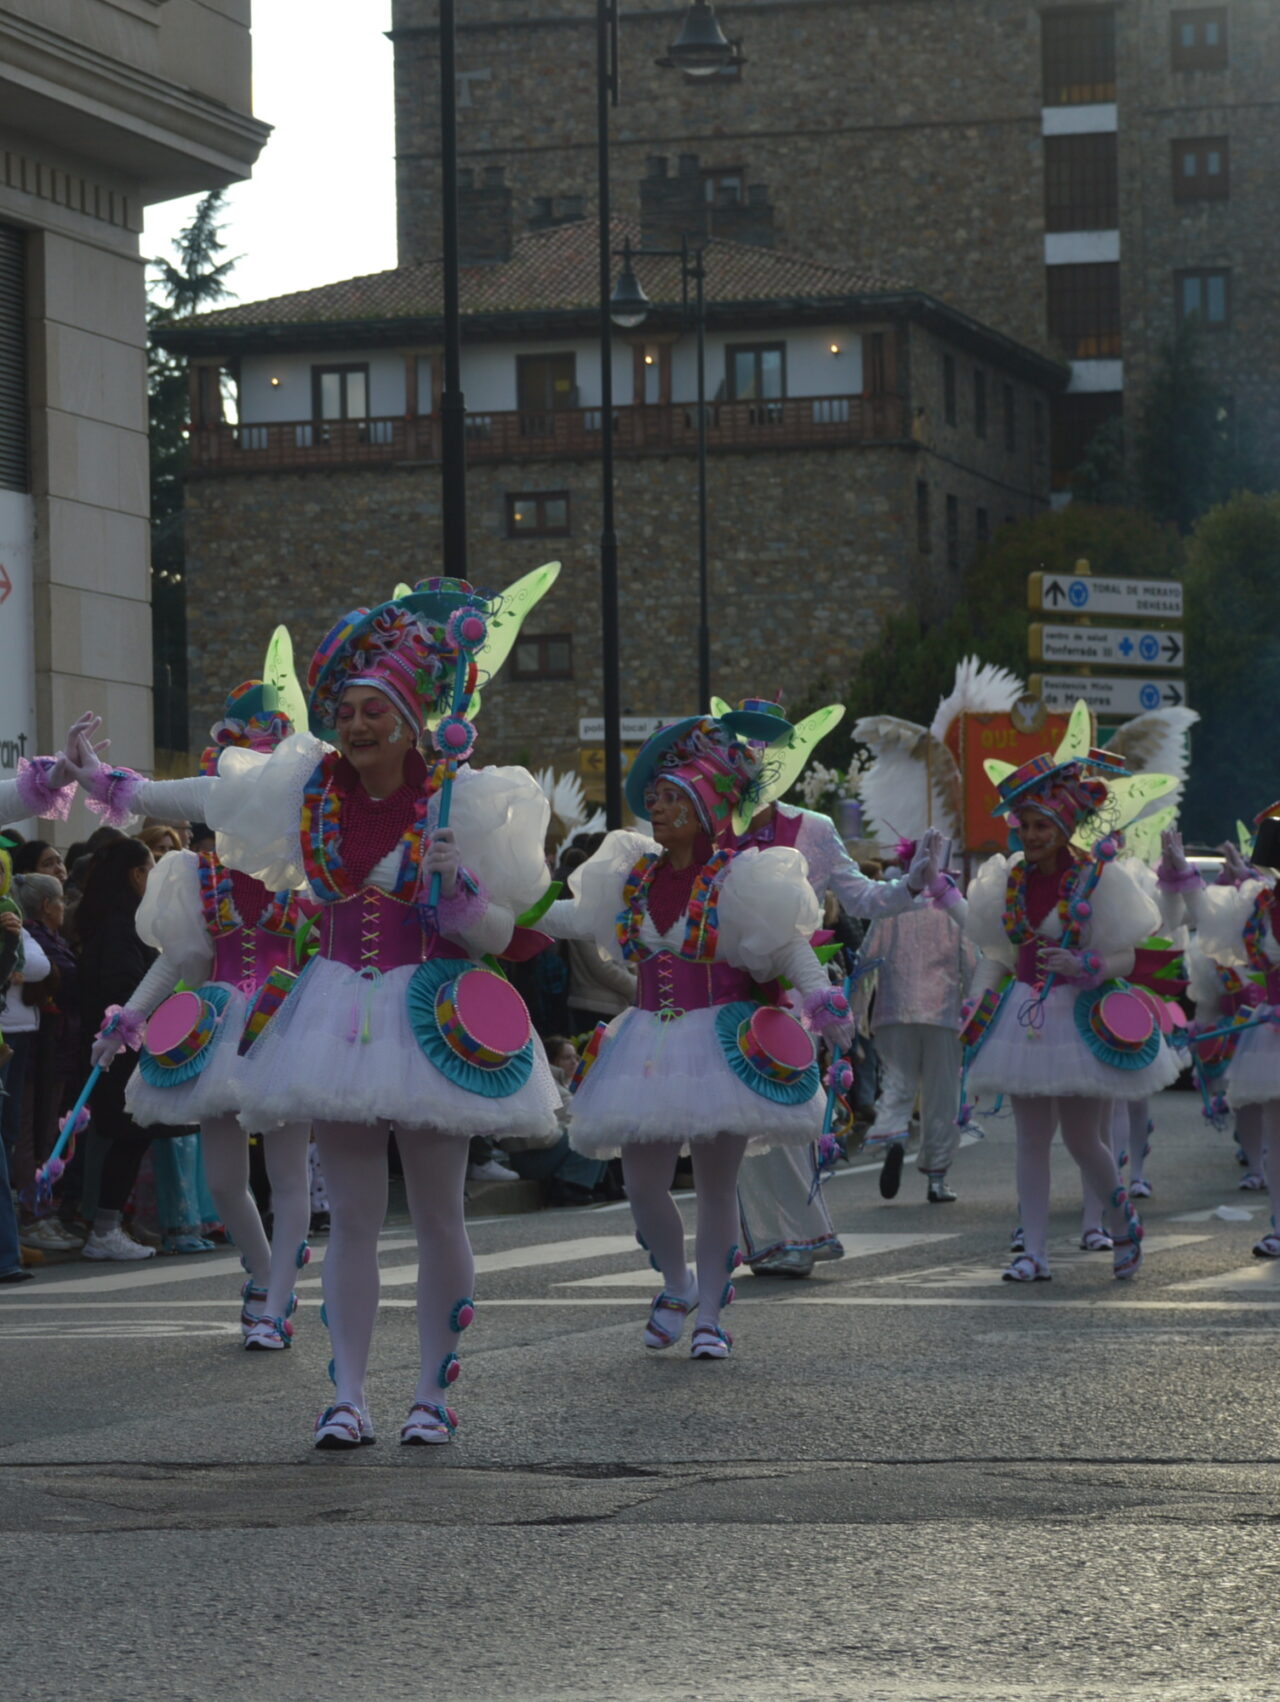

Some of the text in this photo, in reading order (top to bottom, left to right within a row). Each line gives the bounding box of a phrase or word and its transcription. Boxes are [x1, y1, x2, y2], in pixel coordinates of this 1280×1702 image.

[1092, 583, 1181, 598] TORAL DE MERAYO
[1137, 600, 1181, 611] DEHESAS
[1045, 644, 1098, 657] Ponferrada
[1045, 693, 1058, 704] de
[622, 722, 647, 732] local
